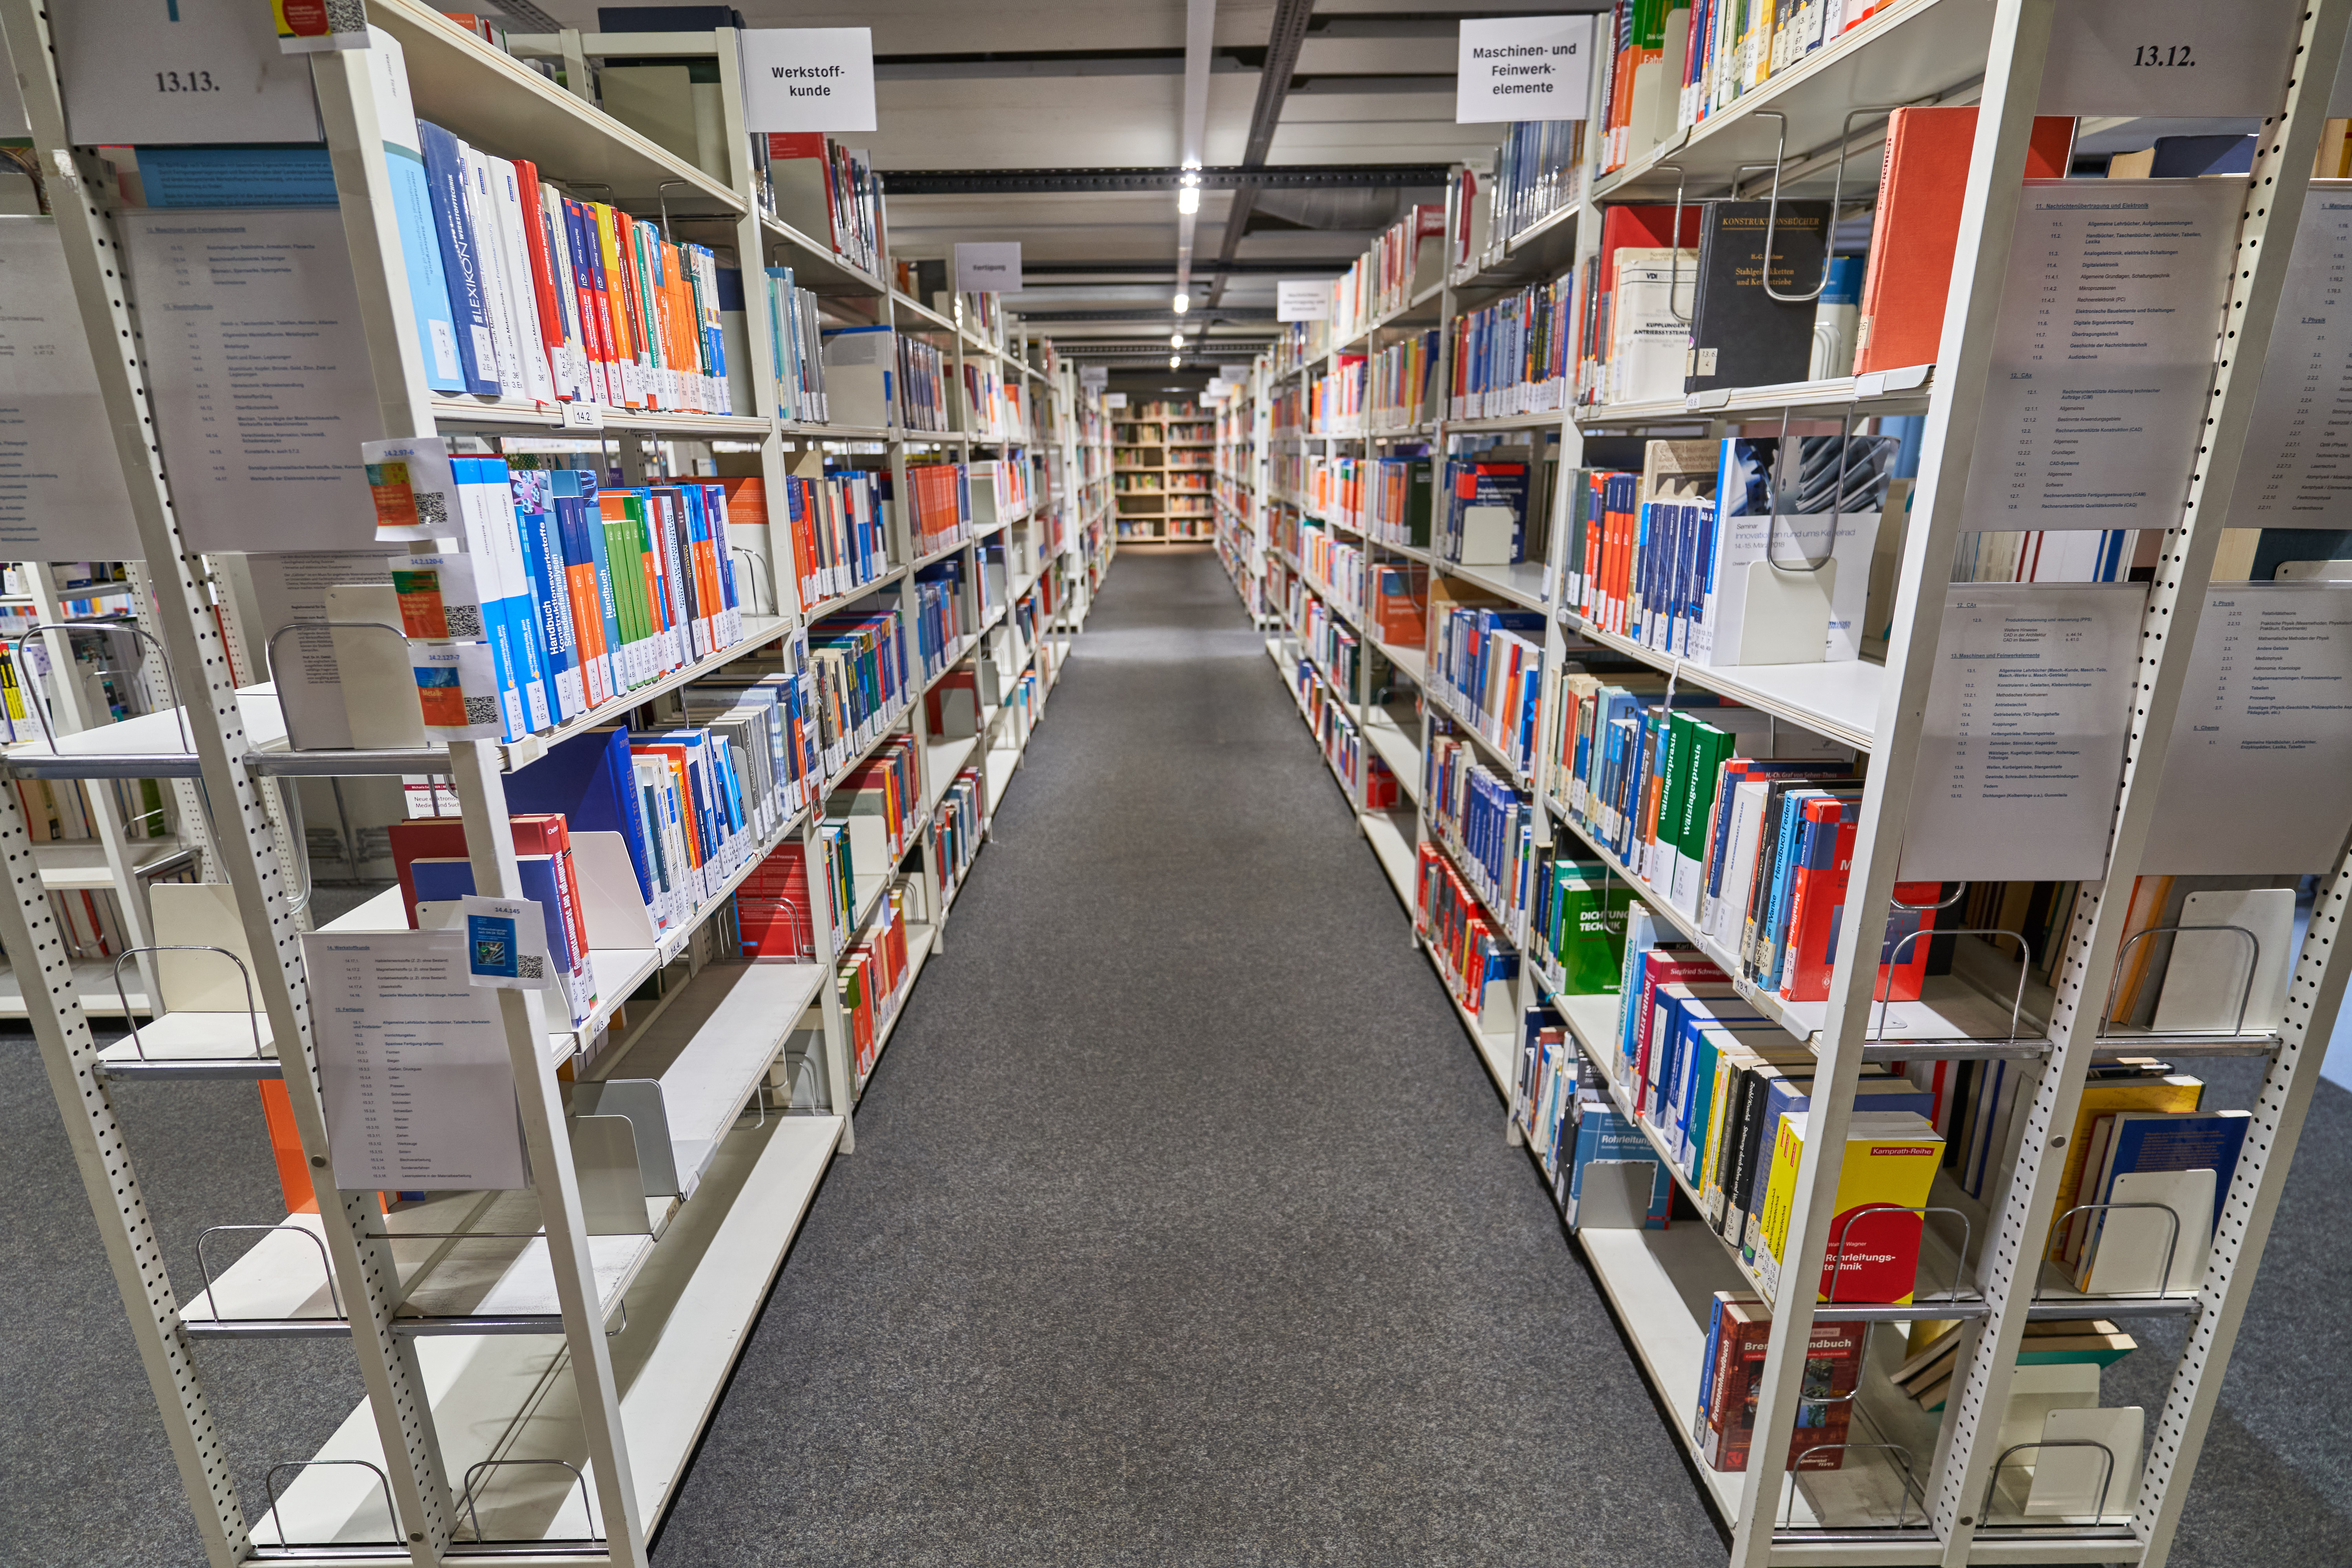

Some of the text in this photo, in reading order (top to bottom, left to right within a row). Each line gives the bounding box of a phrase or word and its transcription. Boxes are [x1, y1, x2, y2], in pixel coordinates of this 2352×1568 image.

[772, 66, 845, 78] Werkstoff-
[1473, 43, 1576, 59] Maschinen- und
[1492, 64, 1555, 76] Feinwerk-
[2133, 45, 2195, 66] 13.12.
[156, 71, 220, 93] 13.13.
[789, 85, 831, 96] kunde
[1493, 82, 1553, 94] elemente
[448, 174, 477, 315] LEXIKON WERKSTOFFTECHNIK
[537, 204, 553, 285] Physikalische Metallkunde
[1722, 217, 1819, 226] KONSTRUKTONSBÜCHER
[585, 306, 595, 348] Fertigungstechnik
[586, 296, 599, 354] Werkstoffwissenschaften
[577, 412, 592, 421] 14.2.
[540, 522, 566, 652] Konstruktionswerkstoffe
[552, 554, 572, 647] Schadensfallanalysen
[599, 569, 613, 619] Handbuch
[543, 601, 559, 655] Handbuch
[1660, 732, 1677, 820] Wälzlagerpraxis
[1683, 744, 1701, 835] Wälzlagerpraxis
[626, 768, 653, 902] SCHLÜSSEL KEY TO STEEL
[681, 784, 692, 844] MAGNETTECHNIK
[1775, 797, 1791, 879] Handbuch Federn
[554, 850, 581, 970] Metallurgie Stahlherstellung
[1788, 892, 1801, 944] Metallfedern
[670, 940, 682, 955] 14.4.
[1618, 938, 1634, 1036] INDUSTRIEARMATUREN
[593, 1021, 605, 1035] 14.3.
[1711, 1339, 1730, 1423] Bremsenhandbuch
